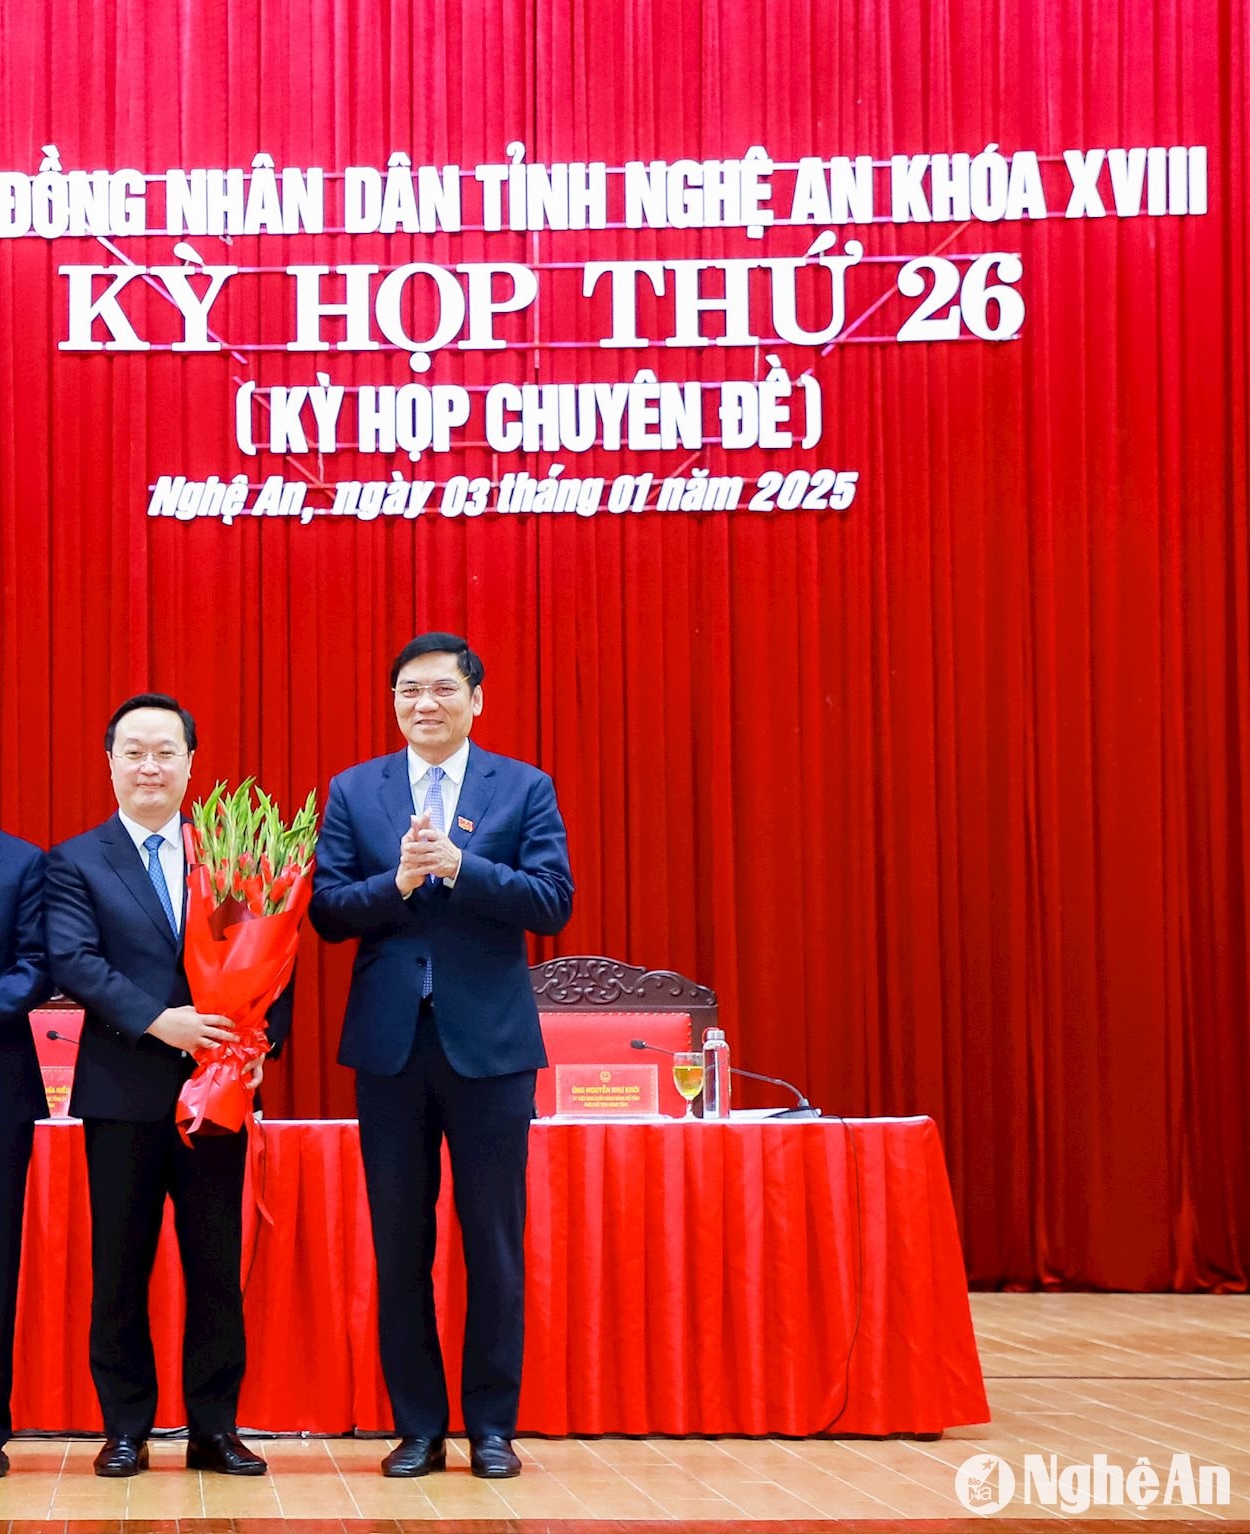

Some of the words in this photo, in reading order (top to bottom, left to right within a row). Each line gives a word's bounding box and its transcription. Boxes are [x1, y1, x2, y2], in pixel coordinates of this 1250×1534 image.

[165, 152, 324, 236] NHÂN
[344, 151, 461, 234] DÂN
[474, 141, 606, 232] TỈNH
[625, 145, 774, 239] NGHỆ
[790, 156, 874, 225] AN
[891, 143, 1048, 222] KHÓA
[1063, 146, 1208, 218] XVIII
[58, 242, 238, 352] KỲ
[286, 262, 539, 373] HỌP
[582, 230, 863, 348] THỨ
[896, 252, 1026, 342] 26
[357, 383, 470, 462] HỌP
[485, 369, 703, 452] CHUYÊN
[147, 474, 249, 525] Nghệ
[333, 470, 437, 522] ngày
[441, 475, 497, 517] 03
[497, 463, 605, 517] tháng
[607, 472, 654, 514] 01
[657, 467, 744, 512] năm
[747, 469, 859, 511] 2025
